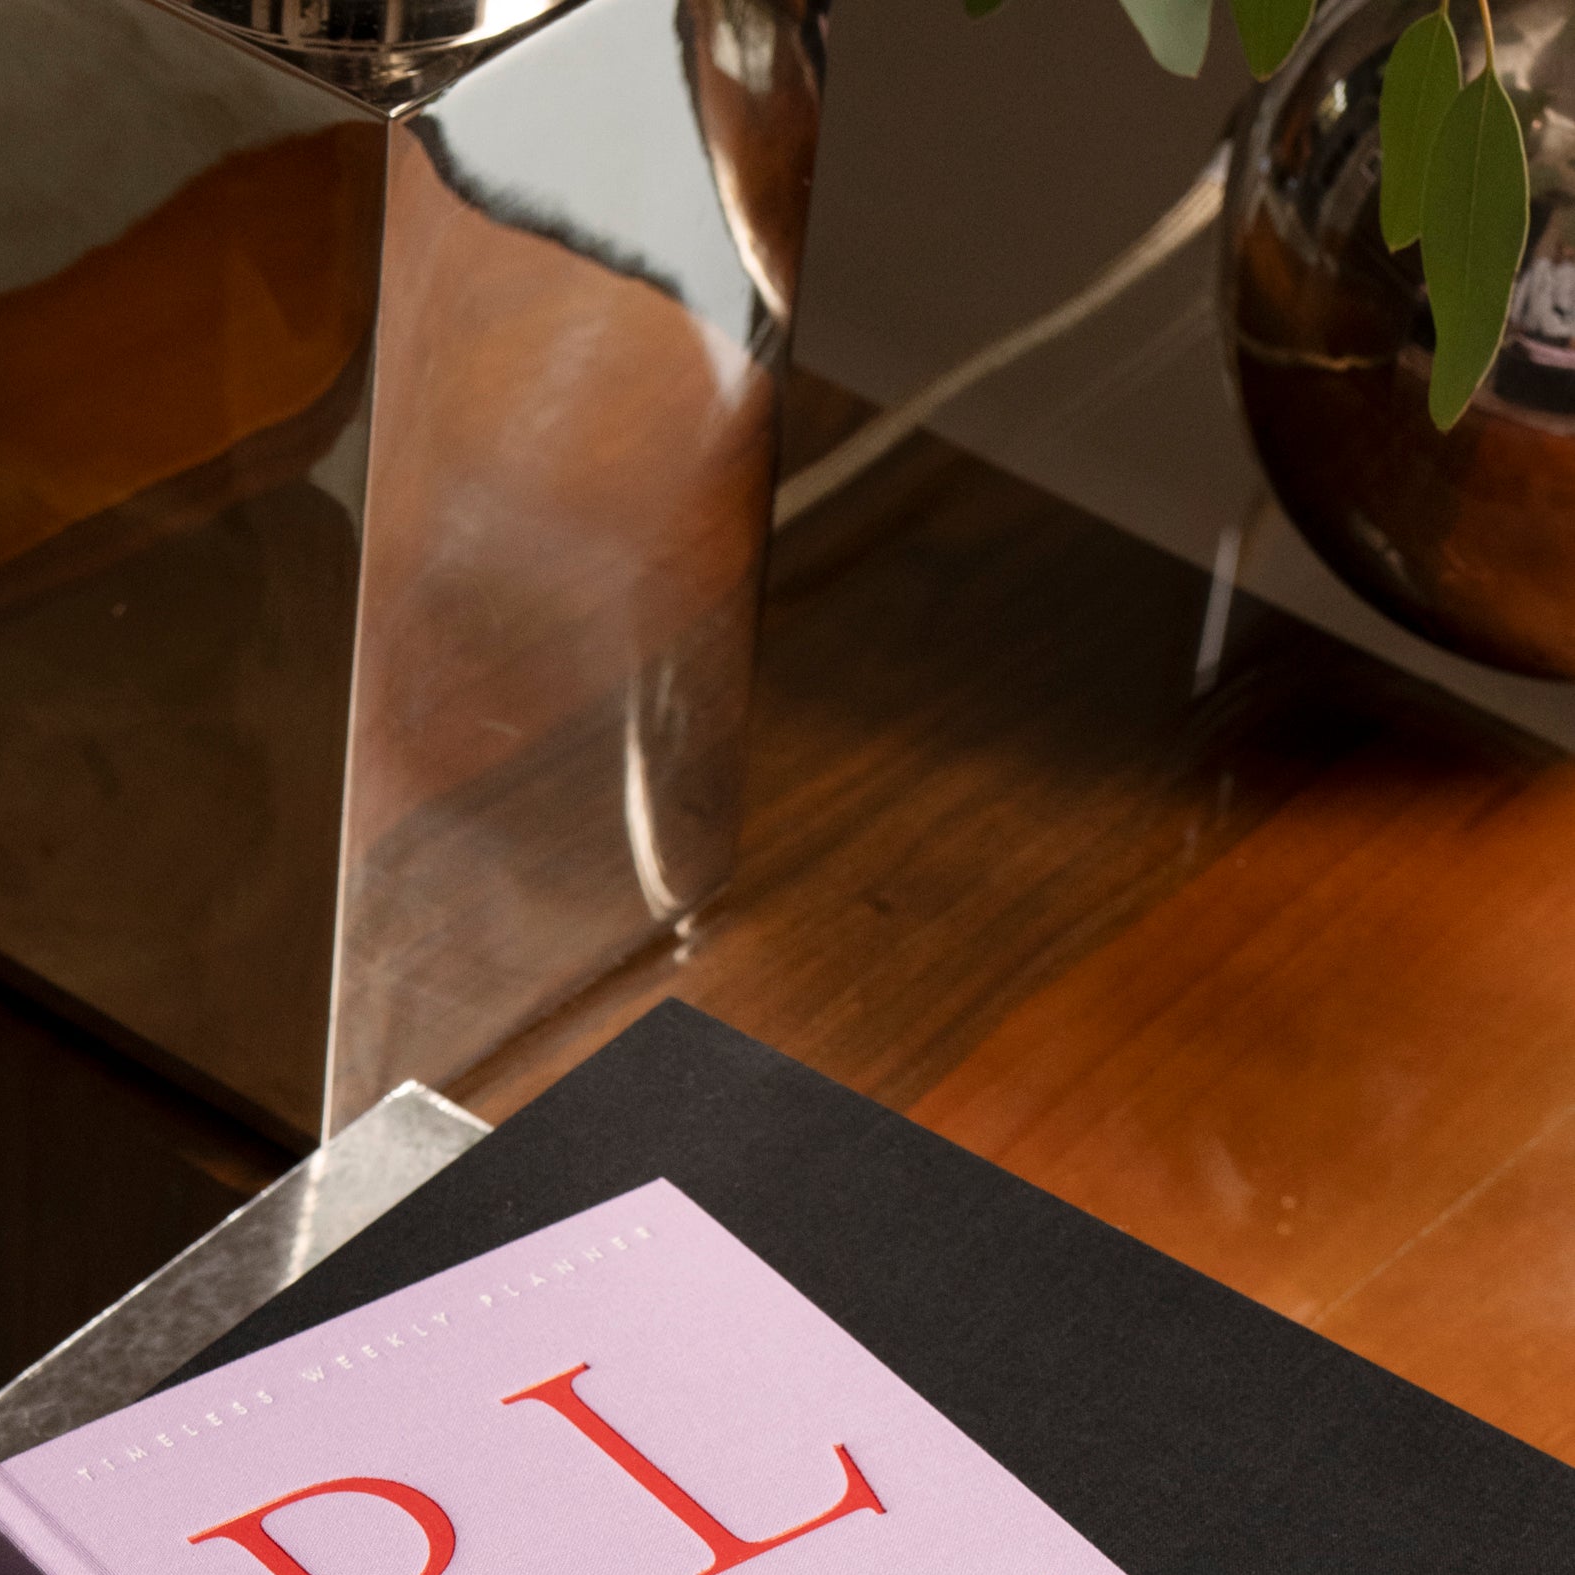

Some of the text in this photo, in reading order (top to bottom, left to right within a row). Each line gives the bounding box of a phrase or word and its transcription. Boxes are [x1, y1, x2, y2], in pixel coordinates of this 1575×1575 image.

[77, 1225, 651, 1482] TIMELESS WEEKLY PLANNER
